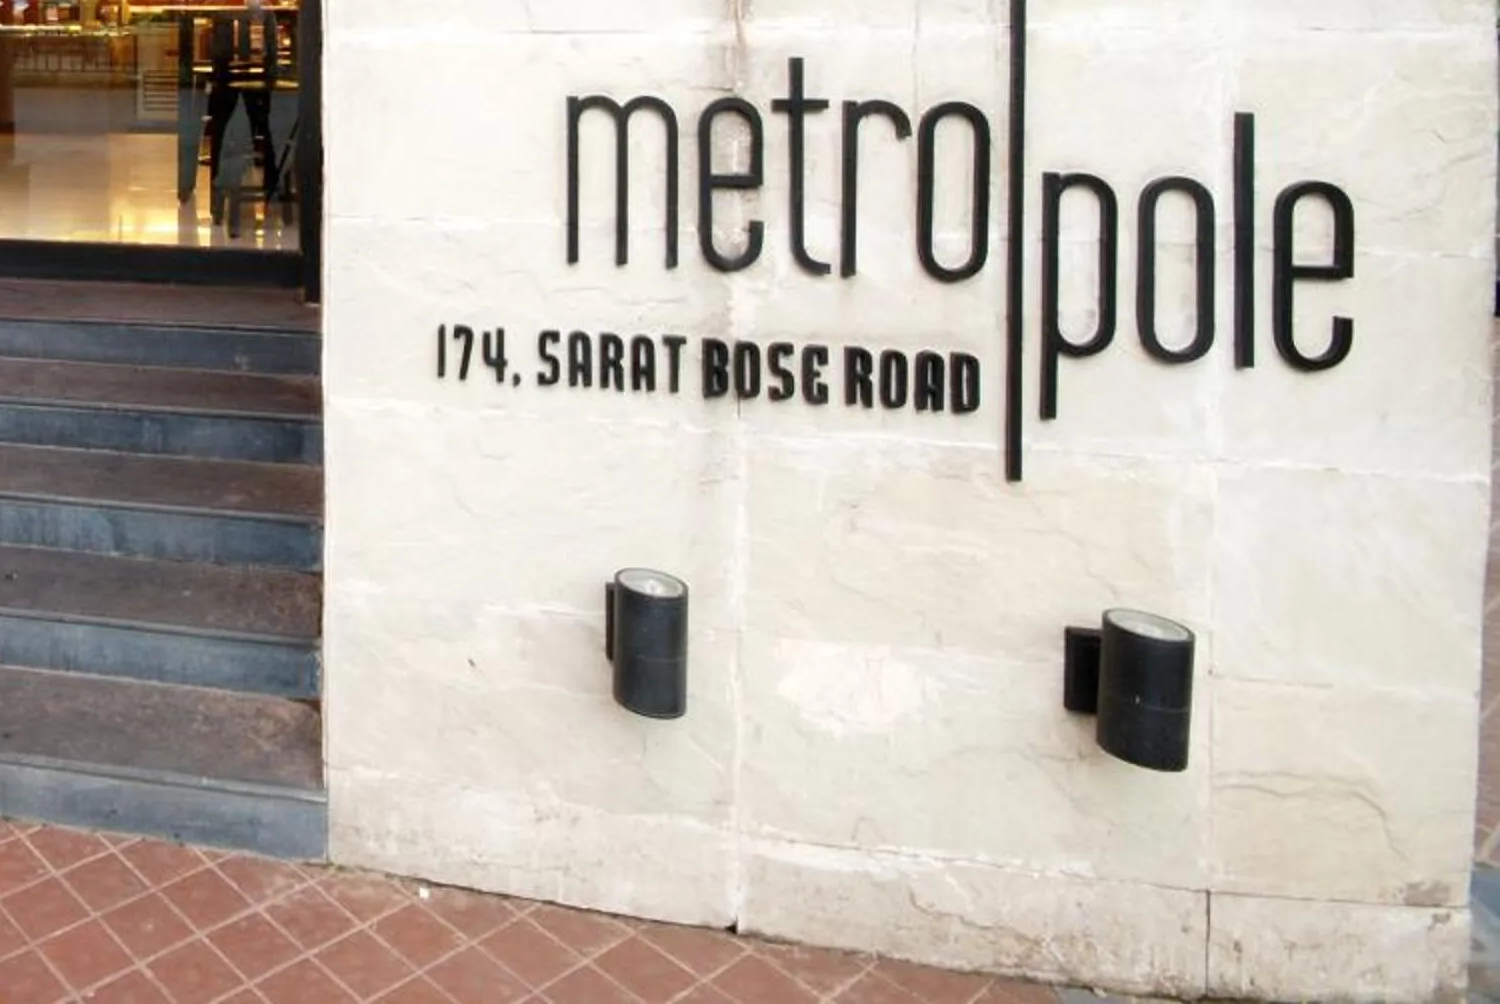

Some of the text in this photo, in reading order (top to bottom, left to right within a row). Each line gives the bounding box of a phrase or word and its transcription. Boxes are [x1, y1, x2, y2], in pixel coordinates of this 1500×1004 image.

[537, 330, 688, 394] SARAT
[701, 336, 831, 406] BOSE
[842, 344, 981, 414] ROAD
